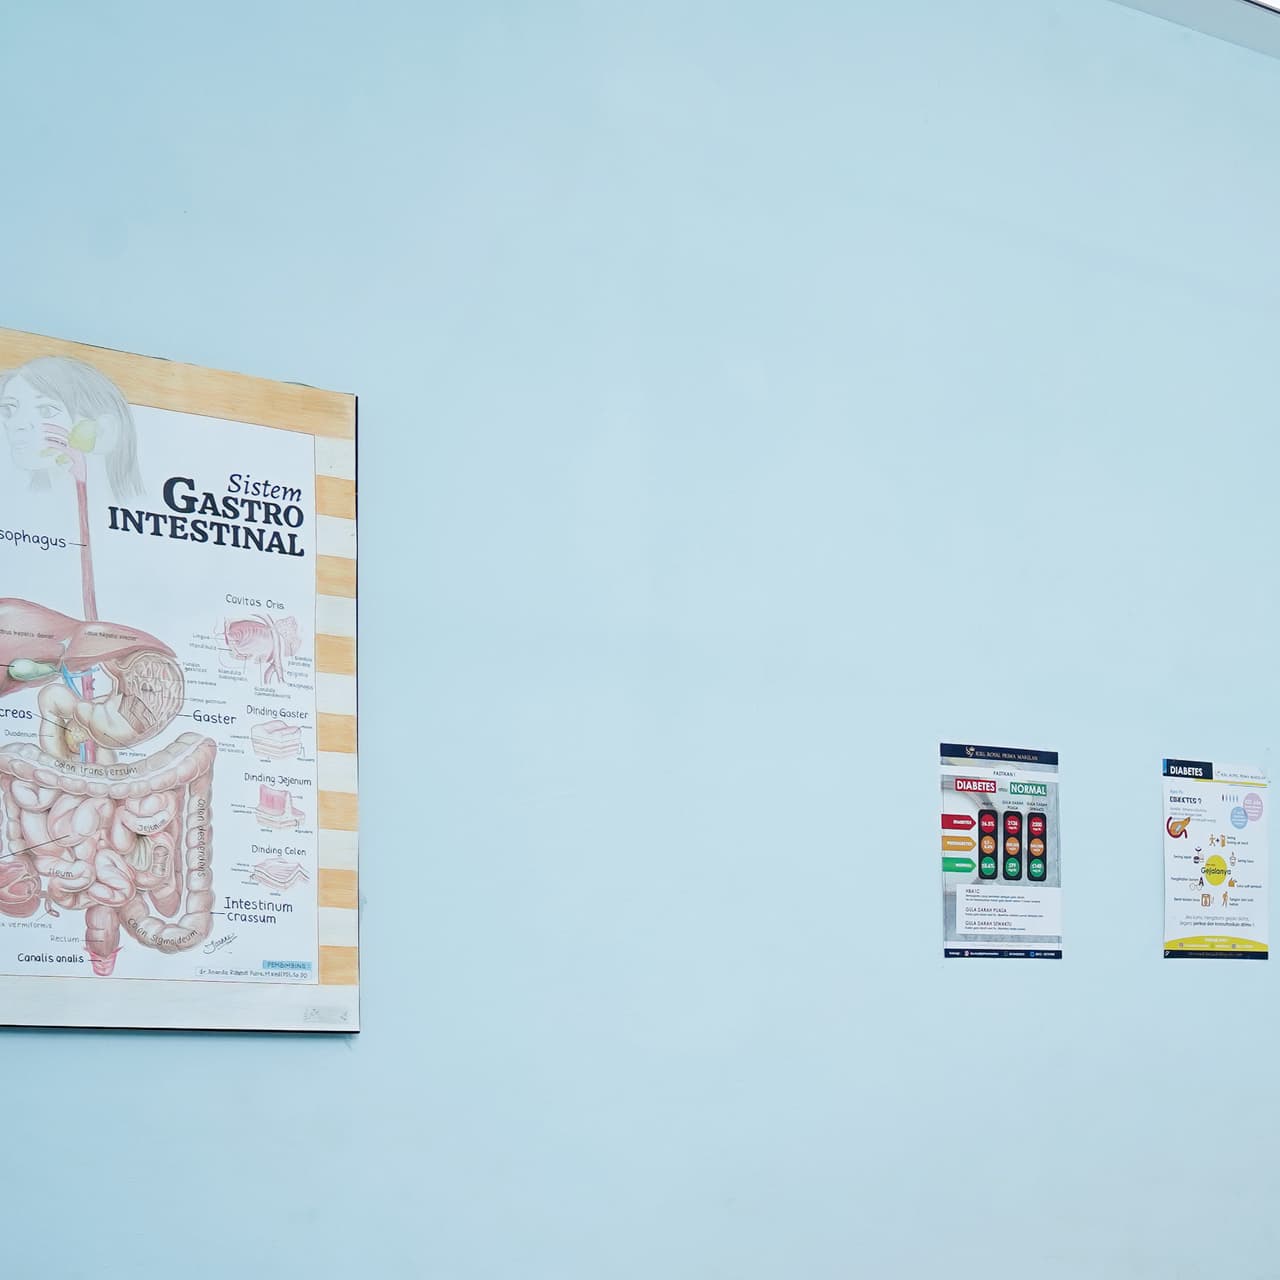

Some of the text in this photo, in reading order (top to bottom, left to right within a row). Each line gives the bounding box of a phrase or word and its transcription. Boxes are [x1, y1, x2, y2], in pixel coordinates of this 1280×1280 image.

[228, 474, 301, 502] Sistem
[108, 503, 304, 557] INTESTINAL
[0, 530, 66, 550] sophagus
[226, 593, 285, 610] Cavitas Oris
[0, 708, 33, 719] creas
[193, 710, 236, 724] Gaster
[247, 705, 308, 719] Dinding Gaster
[1170, 766, 1203, 776] DIABETES
[244, 773, 275, 786] Dinding
[957, 781, 1046, 794] DIABETES NORMAL
[252, 845, 306, 856] Dinding Colon
[224, 896, 293, 912] Intestinum
[227, 912, 276, 924] crassum
[17, 953, 84, 963] Canalis analis
